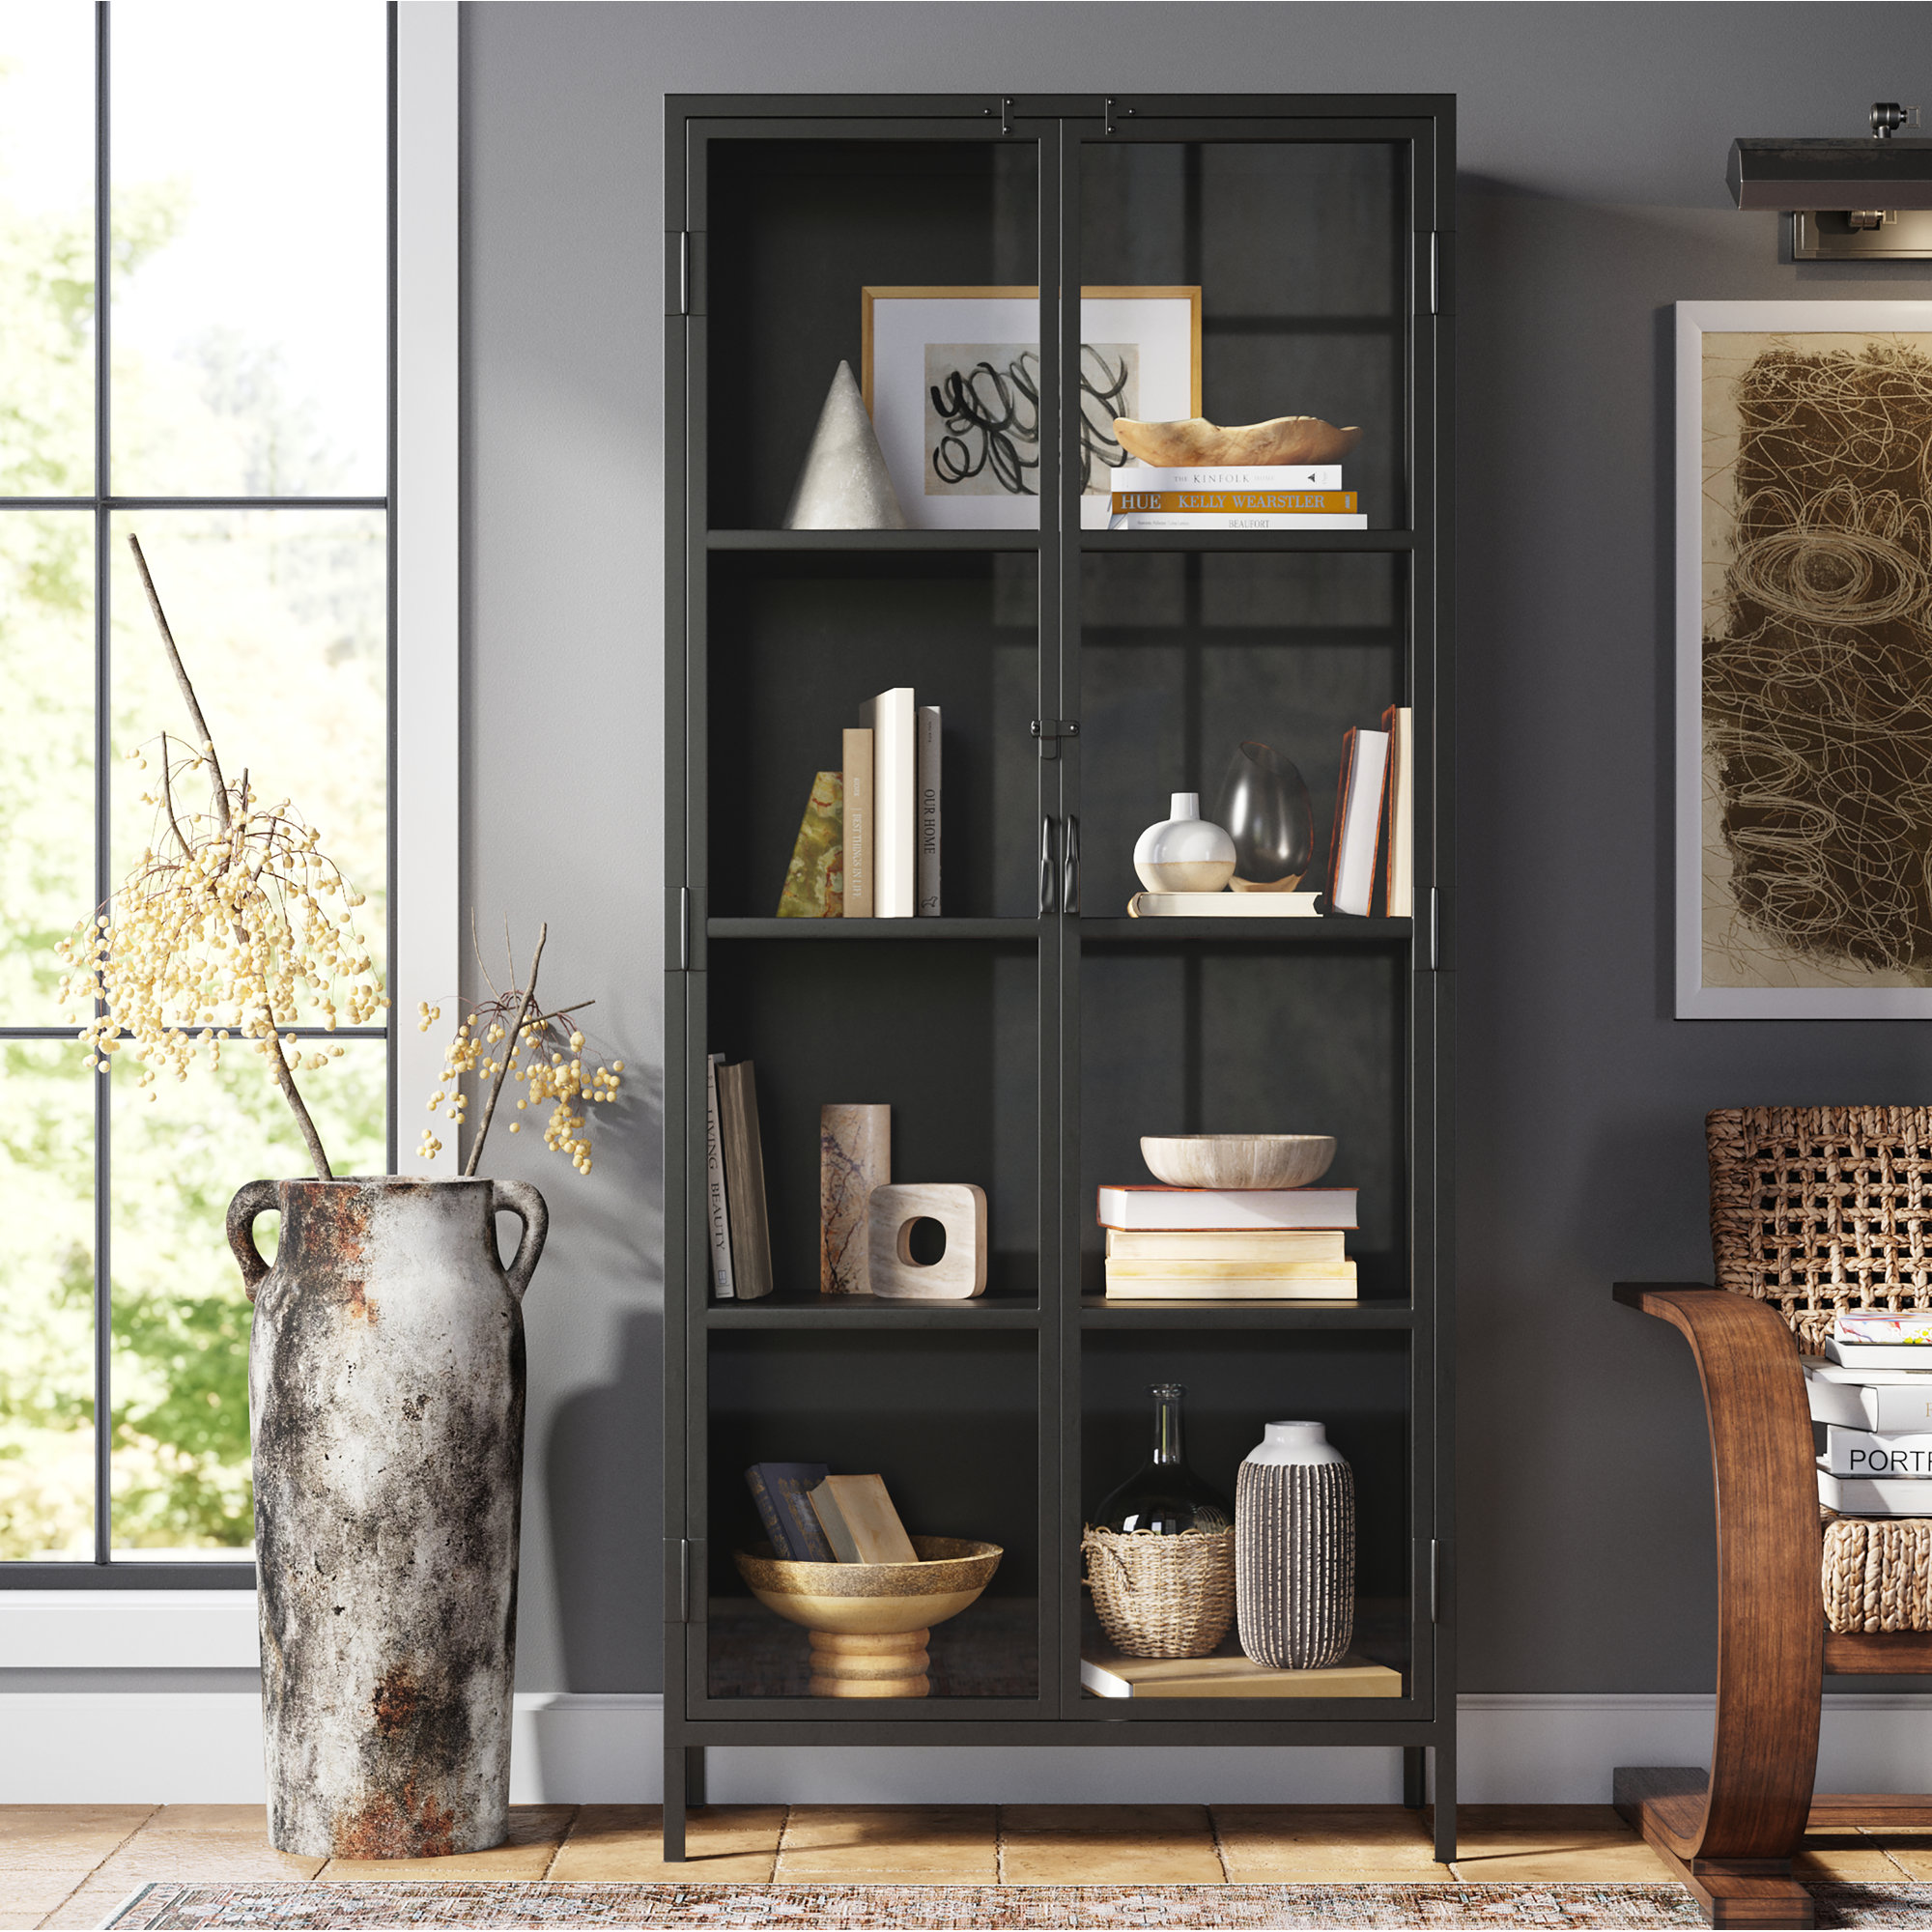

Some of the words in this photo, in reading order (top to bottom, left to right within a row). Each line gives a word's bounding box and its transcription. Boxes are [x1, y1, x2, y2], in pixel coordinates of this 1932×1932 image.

[1193, 473, 1250, 484] KINFOLK
[1121, 493, 1162, 510] HUE
[1179, 494, 1227, 508] KELLY
[1233, 494, 1325, 508] WEARSTLER
[1228, 519, 1270, 529] BEAUFORT
[923, 788, 936, 815] OUR
[923, 818, 936, 855] HOME
[710, 1182, 725, 1250] BEAUTY
[1850, 1449, 1932, 1472] PORT
